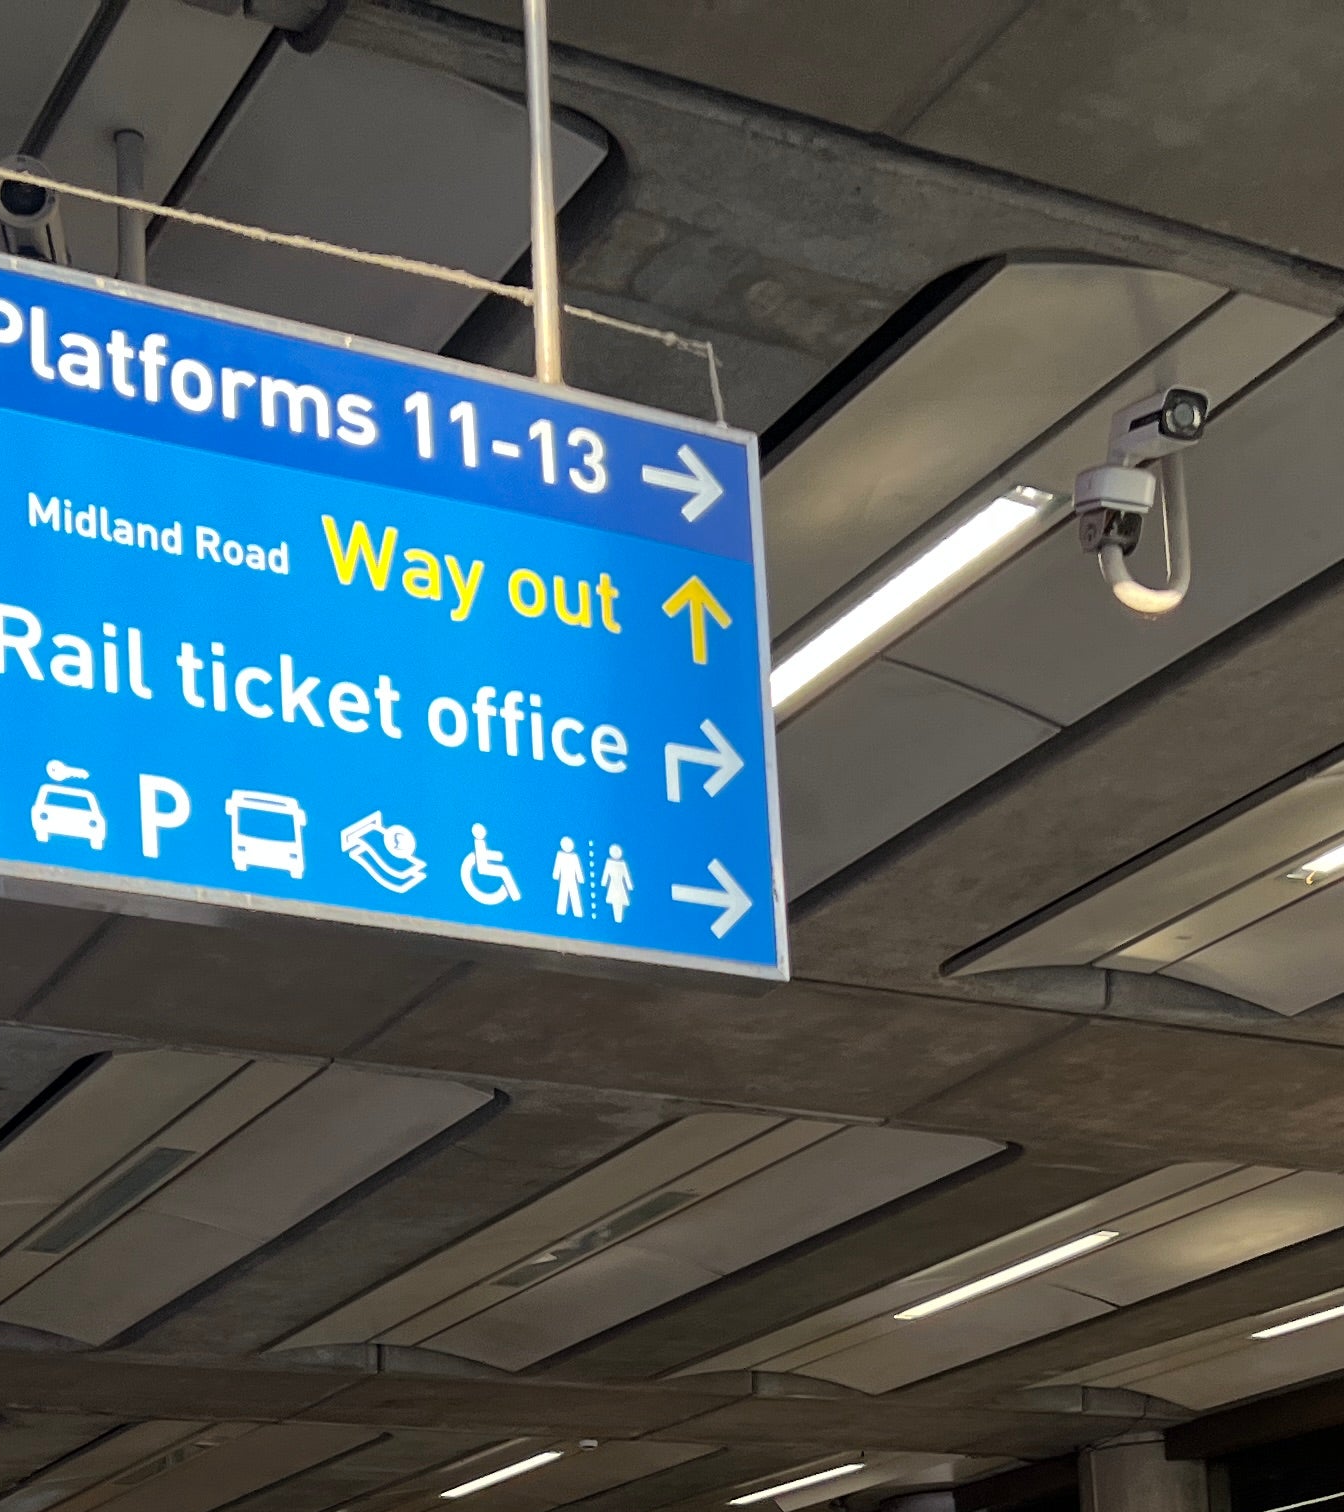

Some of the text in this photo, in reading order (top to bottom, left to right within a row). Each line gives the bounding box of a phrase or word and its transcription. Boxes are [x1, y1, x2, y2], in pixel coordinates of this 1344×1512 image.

[405, 391, 609, 495] 11-13
[29, 492, 290, 576] Midland Road
[322, 514, 622, 635] Way out
[177, 643, 402, 739] ticket
[428, 687, 628, 774] office
[140, 774, 191, 858] P
